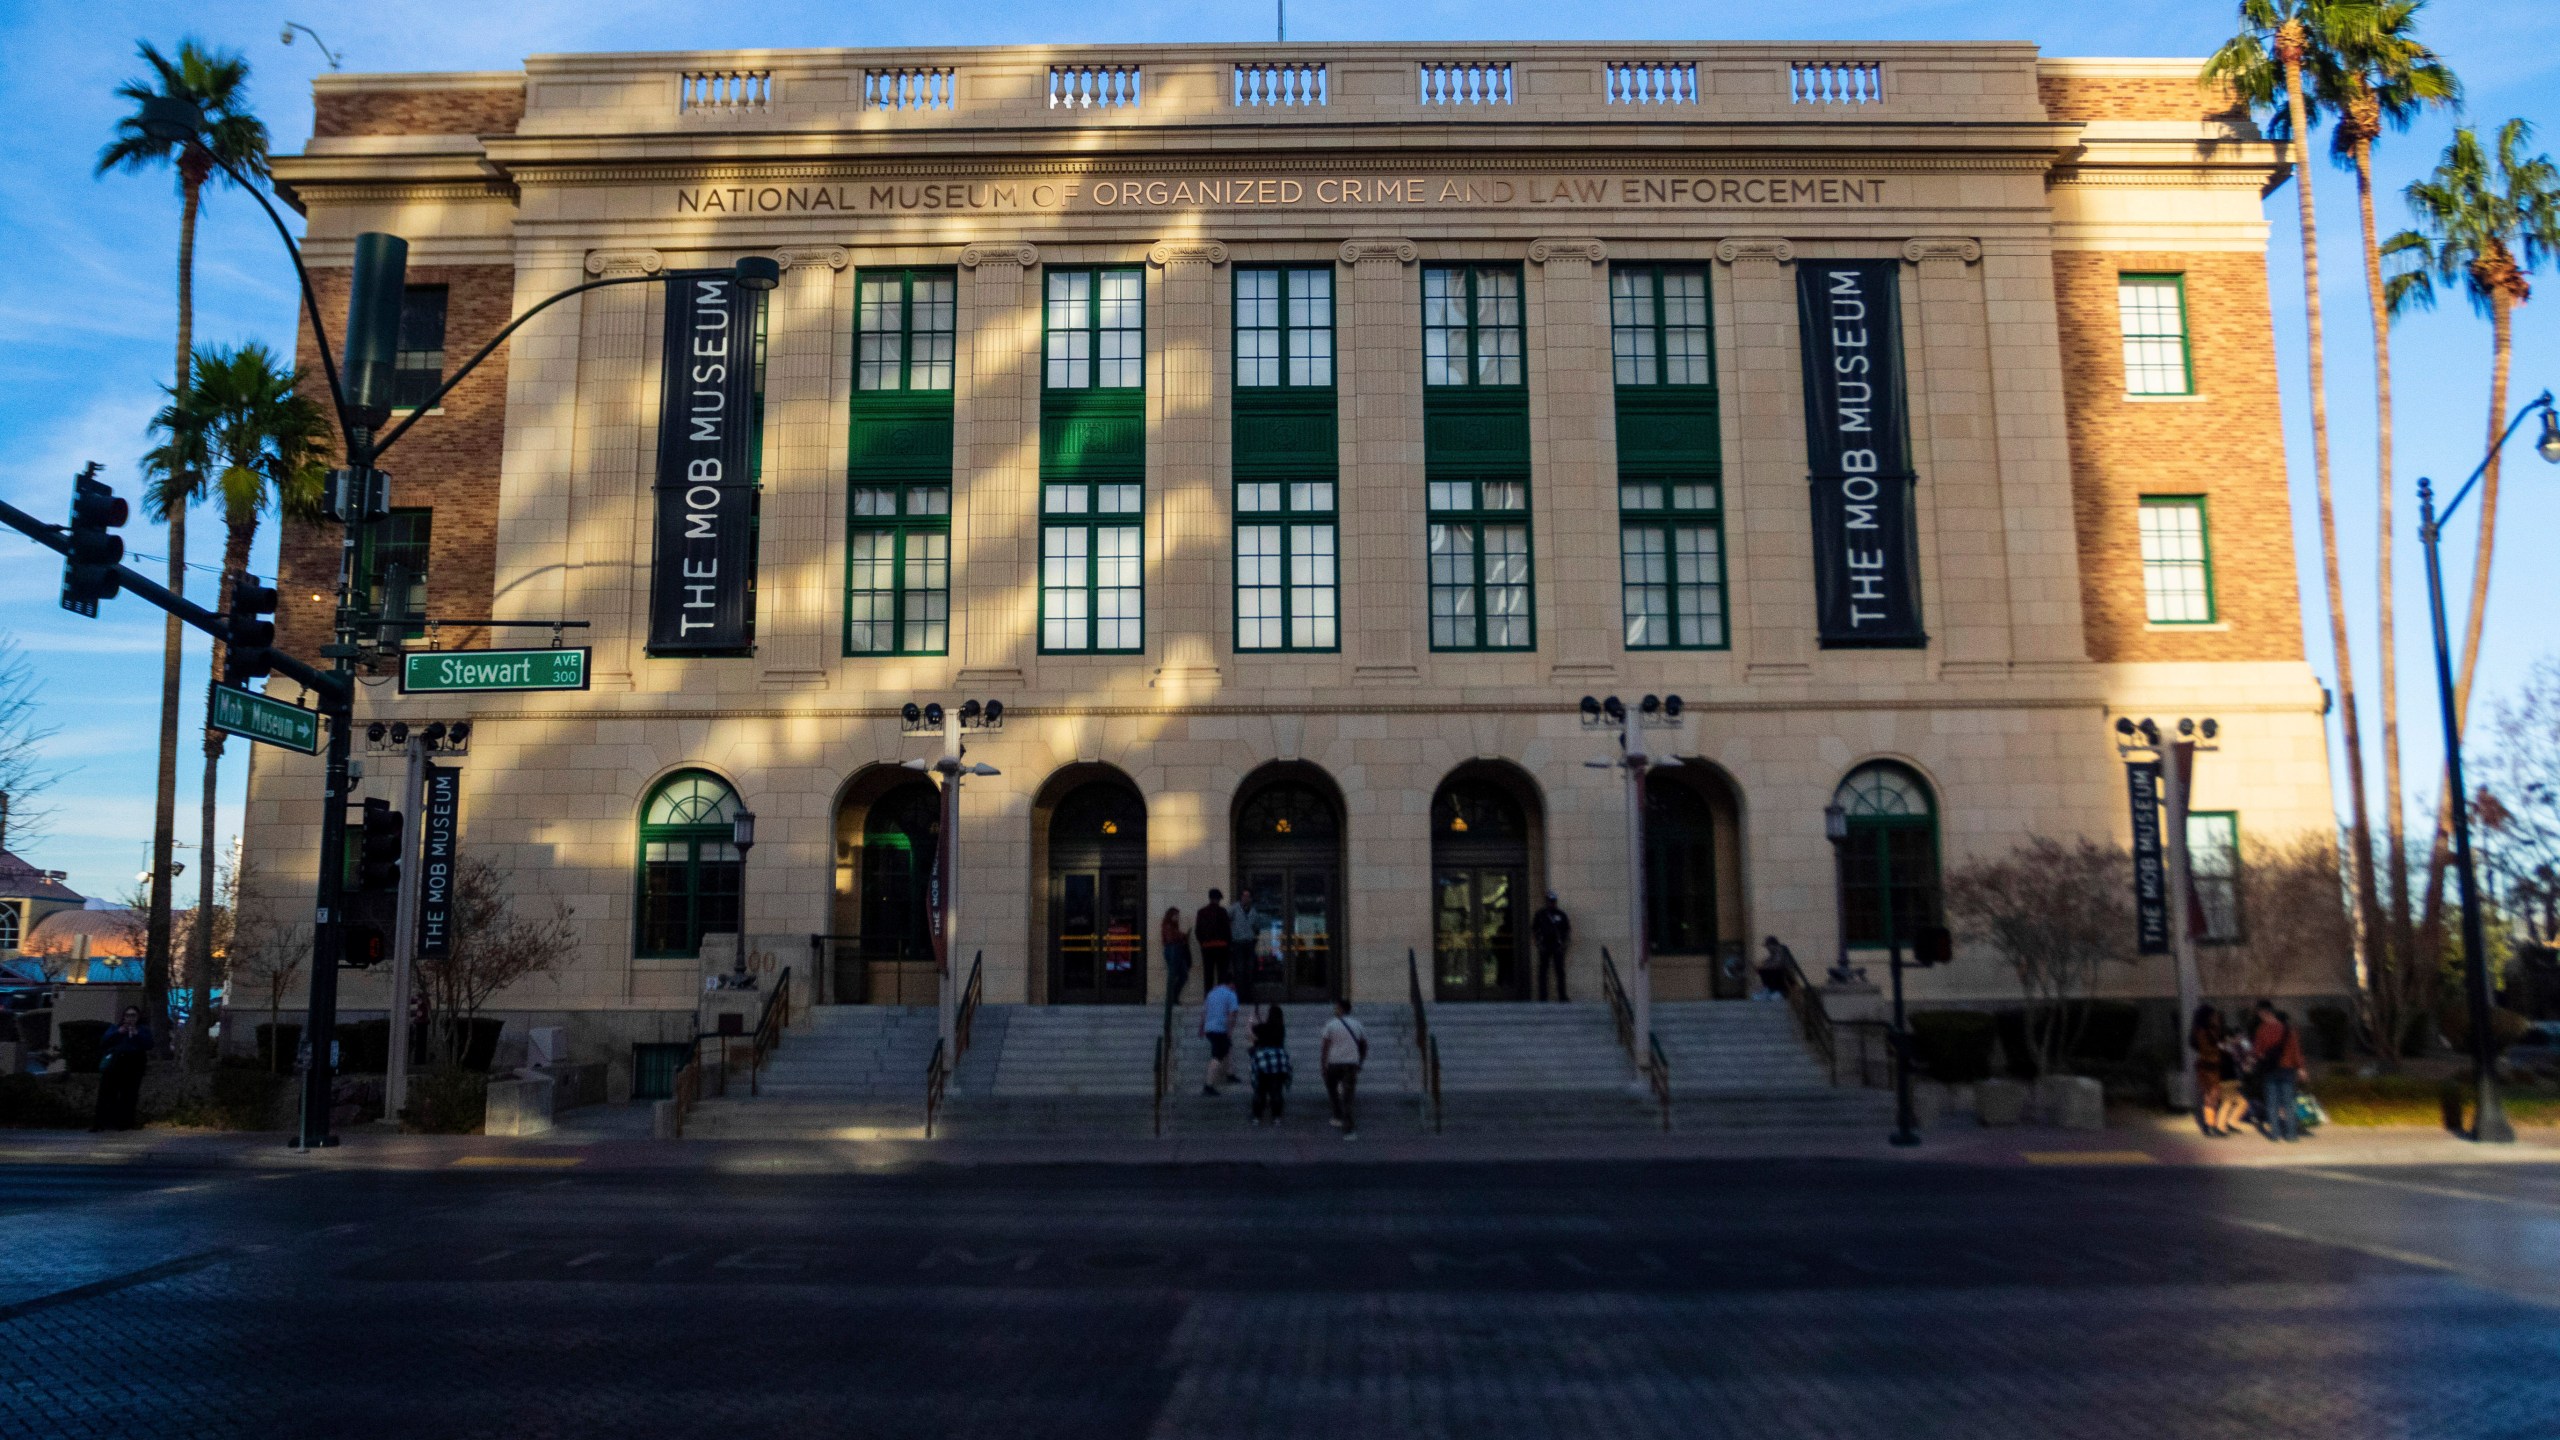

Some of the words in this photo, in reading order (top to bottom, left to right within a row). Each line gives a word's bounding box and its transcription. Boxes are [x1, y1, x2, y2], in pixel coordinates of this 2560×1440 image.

[677, 186, 855, 213] NATIONAL
[869, 184, 1017, 211] MUSEUM
[1032, 183, 1079, 208] OF
[1093, 179, 1303, 206] ORGANIZED
[1316, 179, 1425, 204] CRIME
[1438, 178, 1515, 204] AND
[1530, 178, 1608, 204] LAW
[1622, 178, 1887, 204] ENFORCEMENT
[689, 280, 729, 442] MUSEUM
[1828, 270, 1872, 432] MUSEUM
[685, 457, 722, 539] MOB
[1841, 448, 1879, 529] MOB
[681, 557, 718, 638] THE
[1848, 548, 1887, 628] THE
[411, 658, 419, 670] E
[439, 657, 531, 685] Stewart
[553, 655, 578, 667] AVE
[552, 671, 577, 683] 300
[220, 693, 243, 725] Mob
[251, 702, 294, 740] Museum
[431, 776, 452, 856] MUSEUM
[2132, 769, 2155, 851] MUSEUM
[429, 863, 447, 903] MOB
[931, 879, 939, 907] MOB
[2139, 857, 2159, 899] MOB
[426, 910, 444, 949] THE
[932, 910, 940, 936] THE
[2144, 905, 2163, 943] THE
